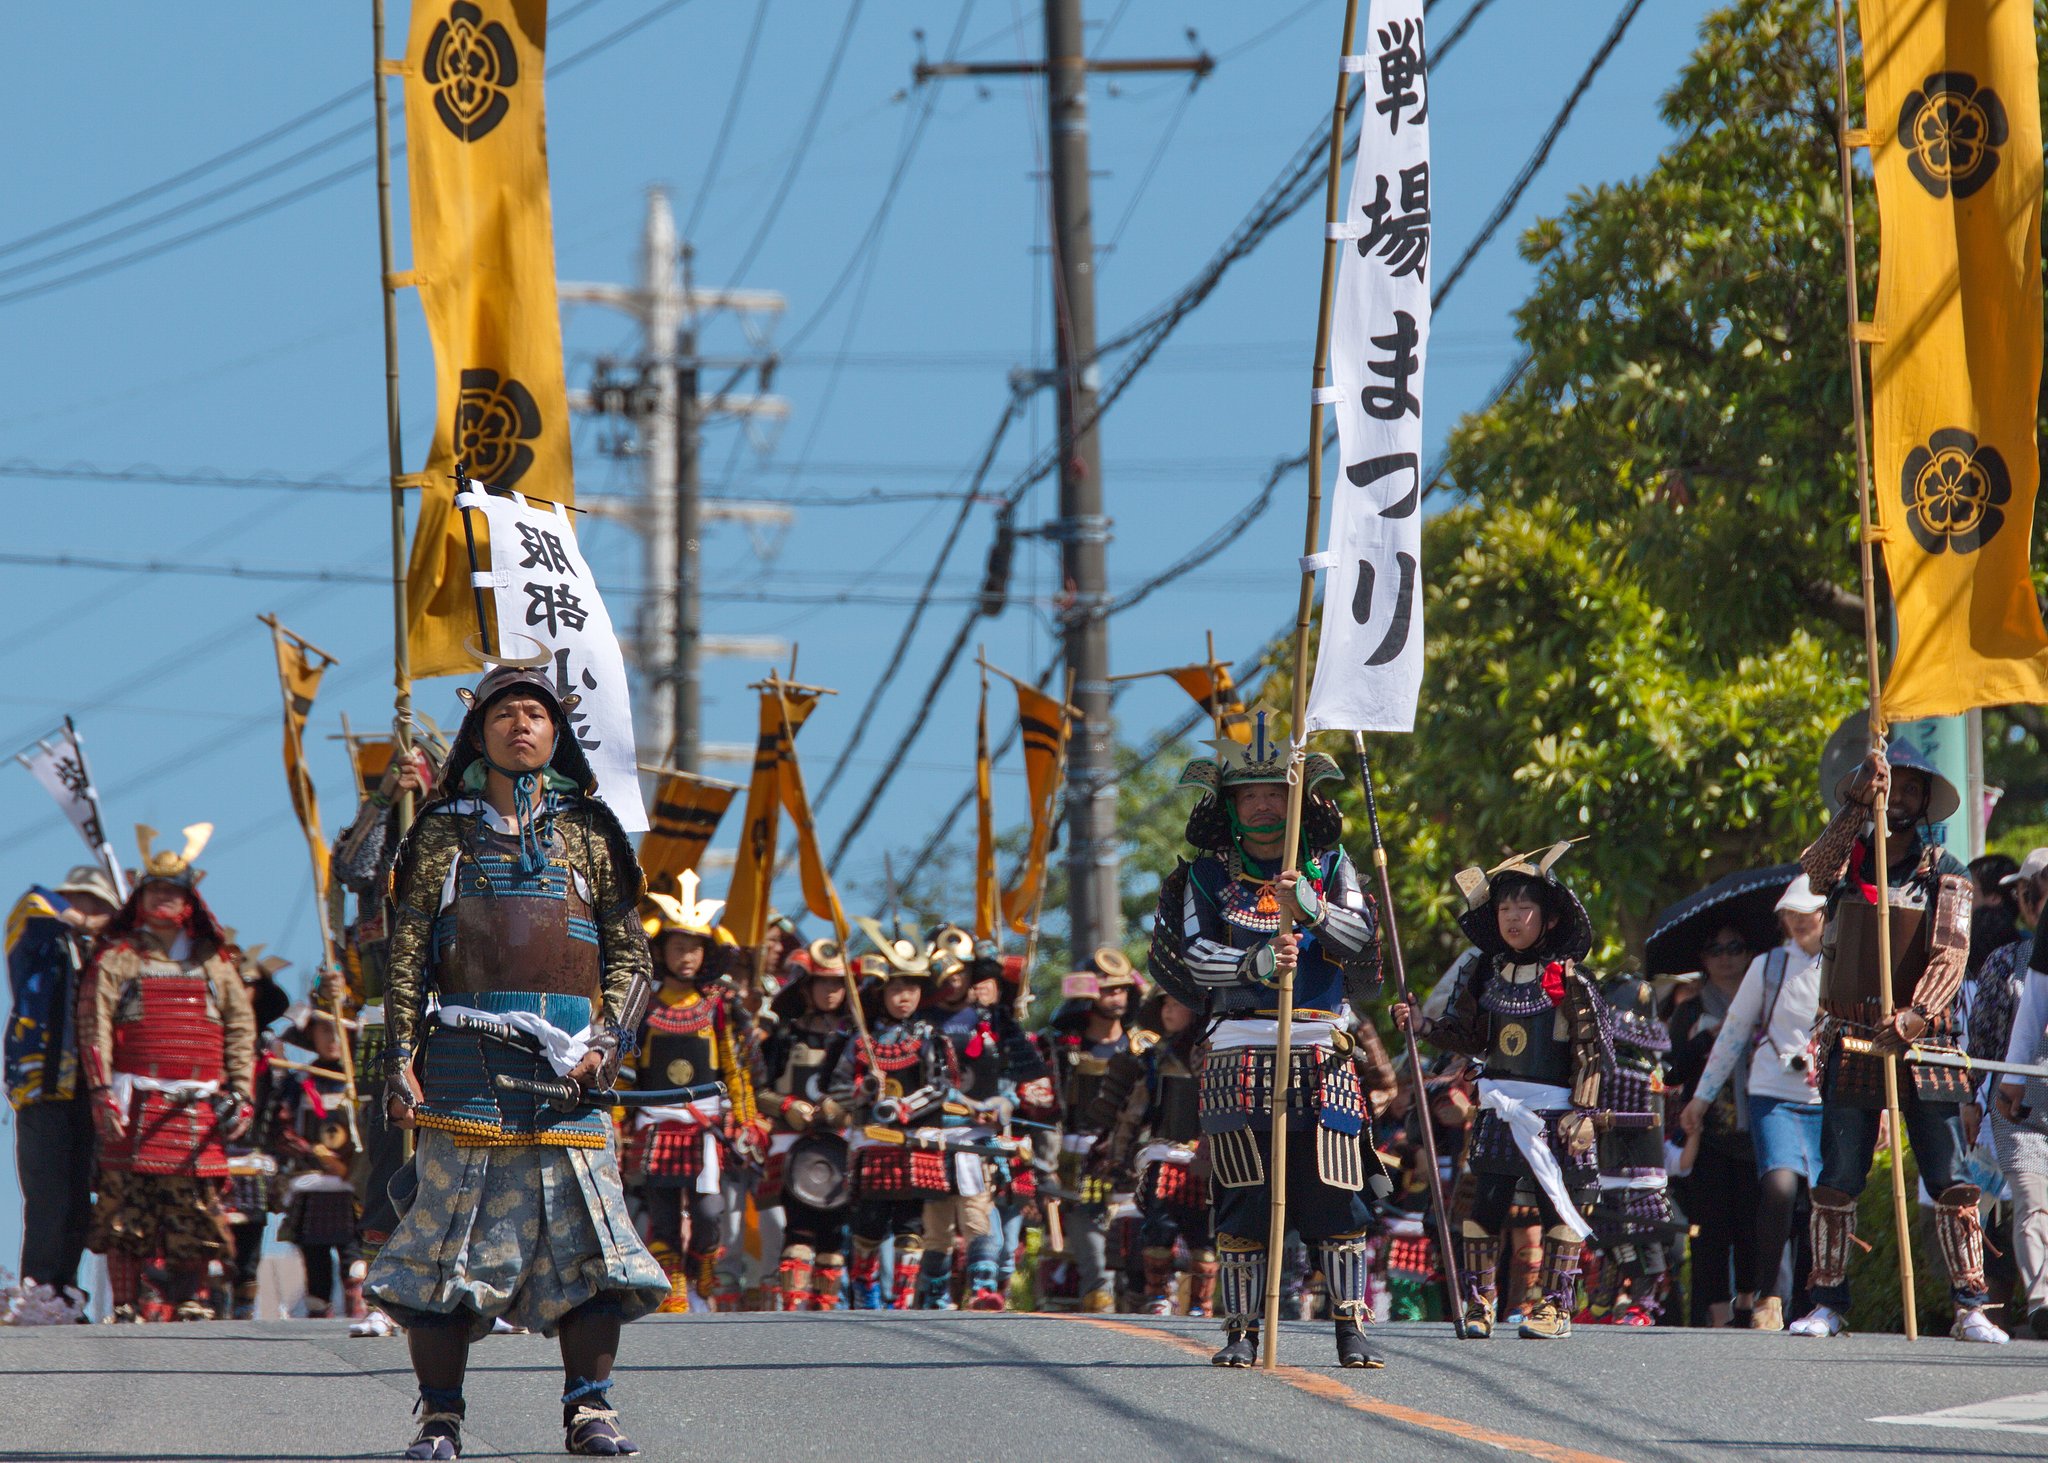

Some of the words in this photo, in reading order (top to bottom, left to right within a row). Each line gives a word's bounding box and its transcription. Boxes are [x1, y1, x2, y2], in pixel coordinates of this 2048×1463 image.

[1345, 17, 1431, 667] 戦場まつり
